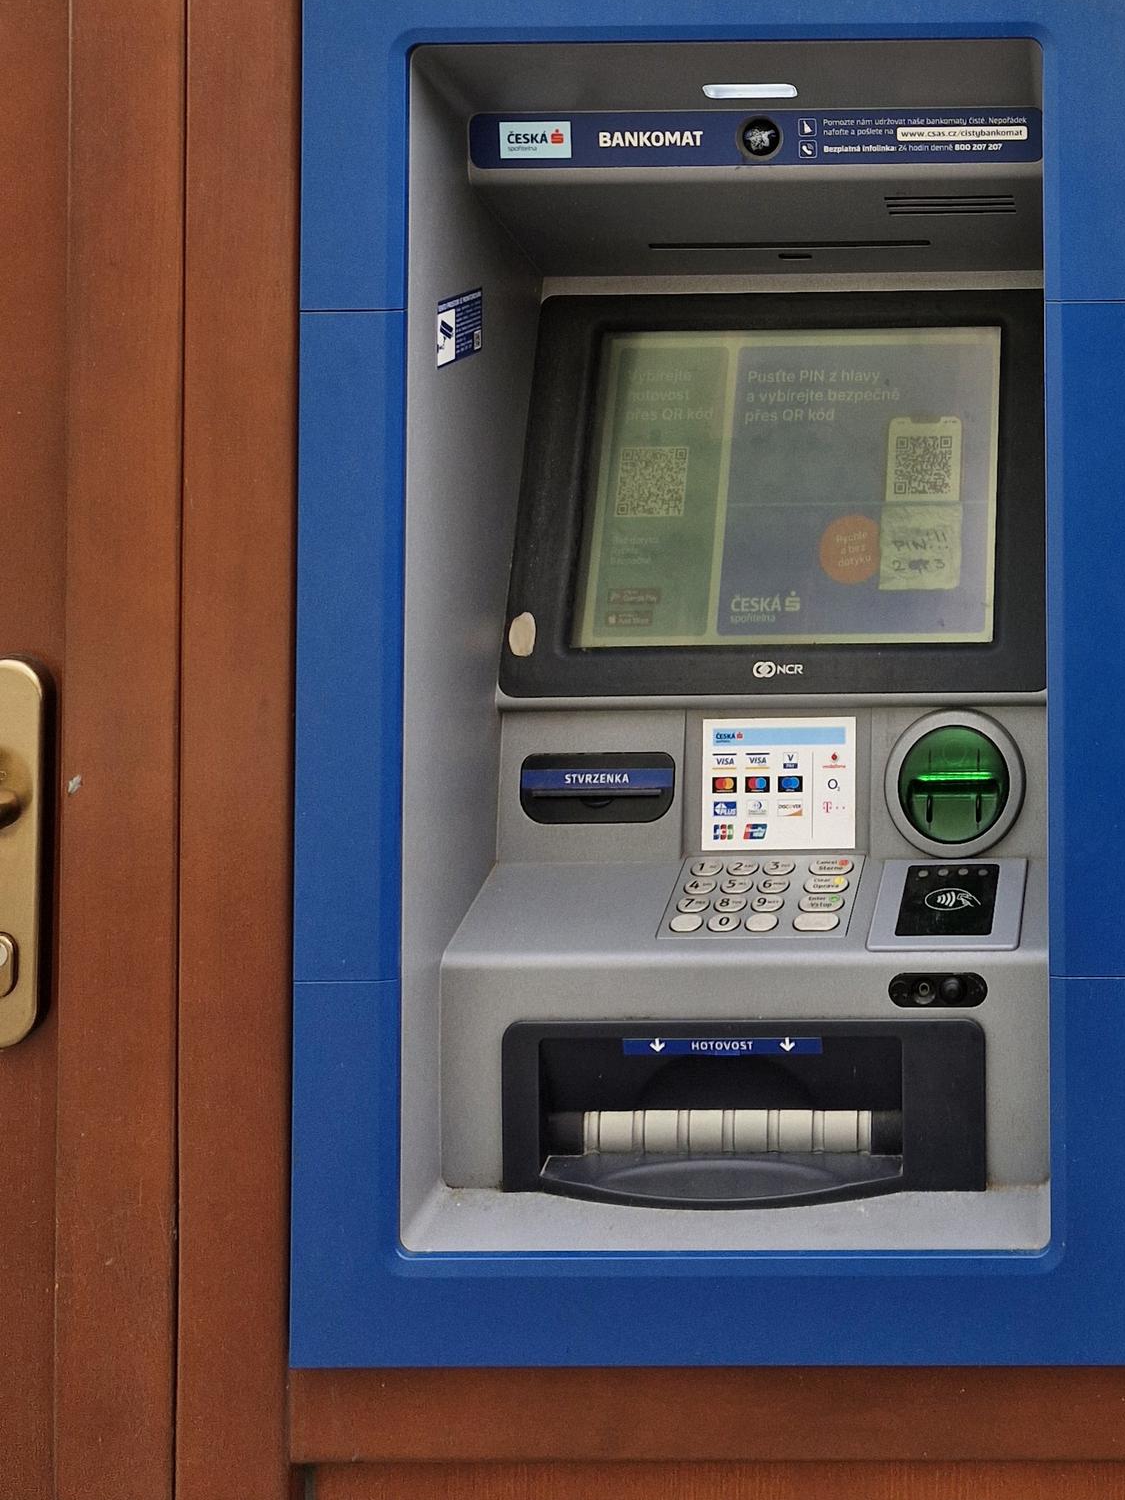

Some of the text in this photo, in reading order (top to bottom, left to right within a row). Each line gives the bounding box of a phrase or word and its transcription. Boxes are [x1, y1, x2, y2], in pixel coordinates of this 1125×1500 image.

[823, 118, 855, 126] Pomozte
[856, 118, 873, 126] nám
[874, 117, 906, 126] udržovat
[907, 117, 924, 125] naše
[926, 116, 967, 126] bankomaty
[989, 116, 1027, 125] Nepořádek
[507, 131, 549, 144] ČESKÁ
[857, 127, 883, 137] pošlete
[901, 128, 1023, 138] www.csas.cz/cistybankomat
[598, 131, 704, 148] BANKOMAT
[823, 144, 861, 153] Bezplatná
[908, 143, 930, 151] hodin
[930, 143, 954, 151] denně
[954, 143, 971, 151] 800
[972, 143, 986, 151] 207
[748, 369, 880, 384] Pusťte PIN z hlavy
[747, 388, 901, 405] a vybírejte bezpečně
[745, 408, 835, 424] přes QR kód
[837, 554, 872, 568] dotyku
[730, 593, 781, 612] ČESKÁ
[730, 612, 776, 624] spořitelna
[777, 664, 804, 675] NCR
[715, 732, 736, 740] ČESKÁ
[787, 754, 794, 762] V
[564, 773, 630, 784] STVRZENKA
[699, 862, 706, 871] 1
[733, 862, 743, 871] 2
[770, 861, 780, 870] 3
[689, 880, 700, 889] 4
[726, 879, 737, 888] 5
[763, 879, 772, 889] 6
[685, 898, 695, 908] 7
[719, 898, 730, 907] 8
[757, 897, 767, 907] 9
[718, 916, 730, 927] 0
[691, 1041, 753, 1051] HOTOVOST
